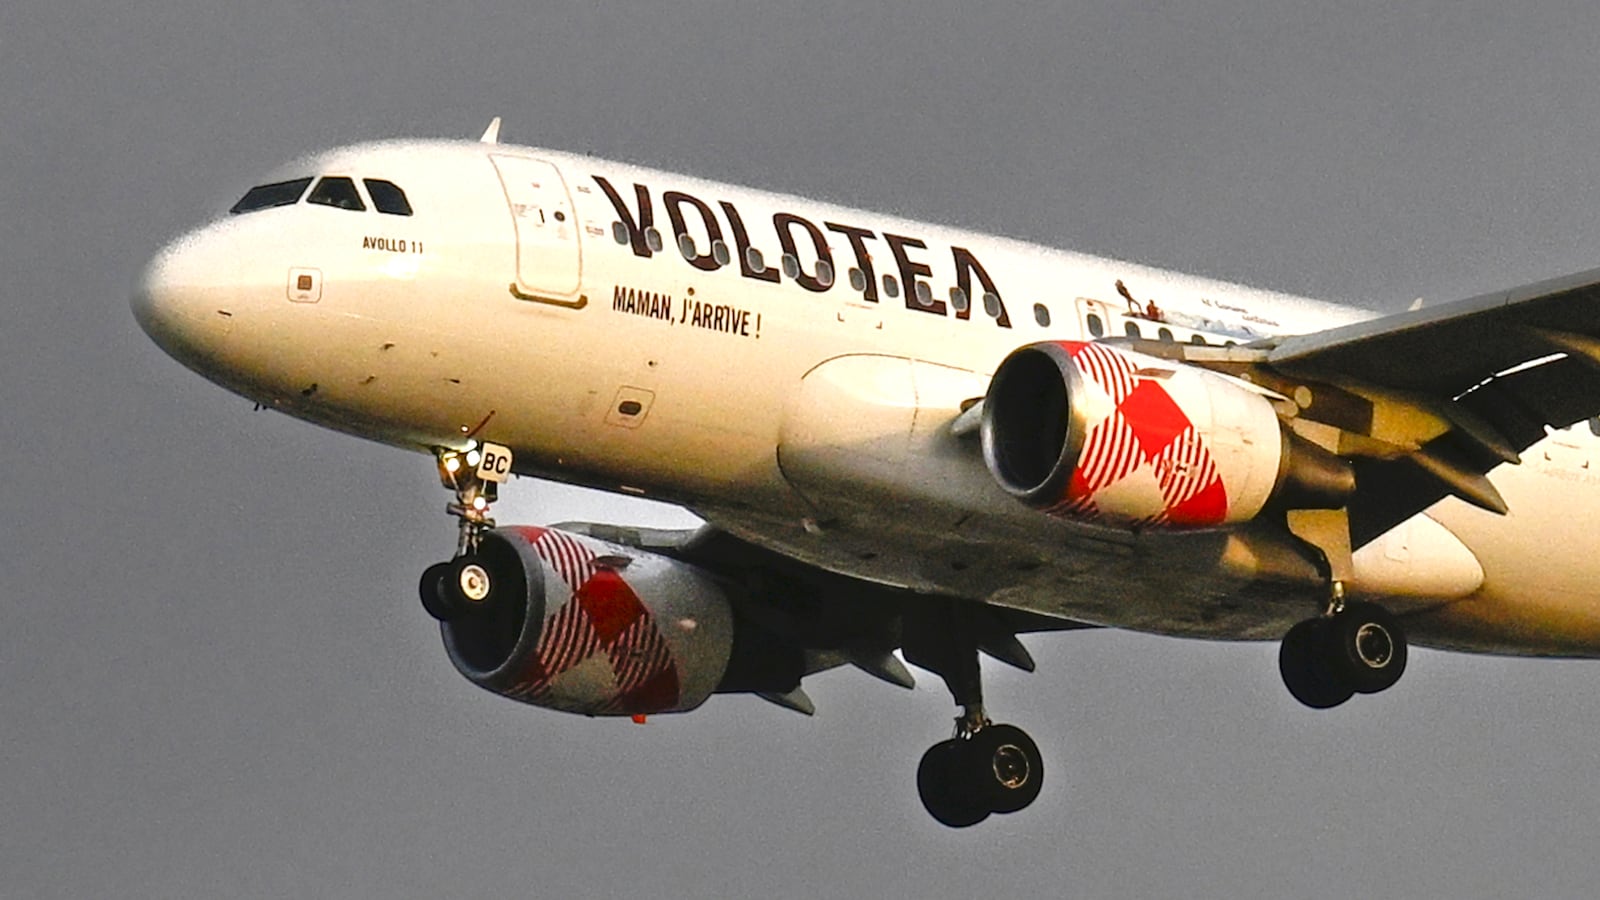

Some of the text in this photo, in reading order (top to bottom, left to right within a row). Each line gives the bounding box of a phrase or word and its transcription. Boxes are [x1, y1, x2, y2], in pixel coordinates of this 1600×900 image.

[362, 235, 424, 255] AVOLLO 11
[591, 174, 1013, 329] VOLOTEA
[612, 284, 675, 326] MAMAN,
[482, 452, 508, 474] BC
